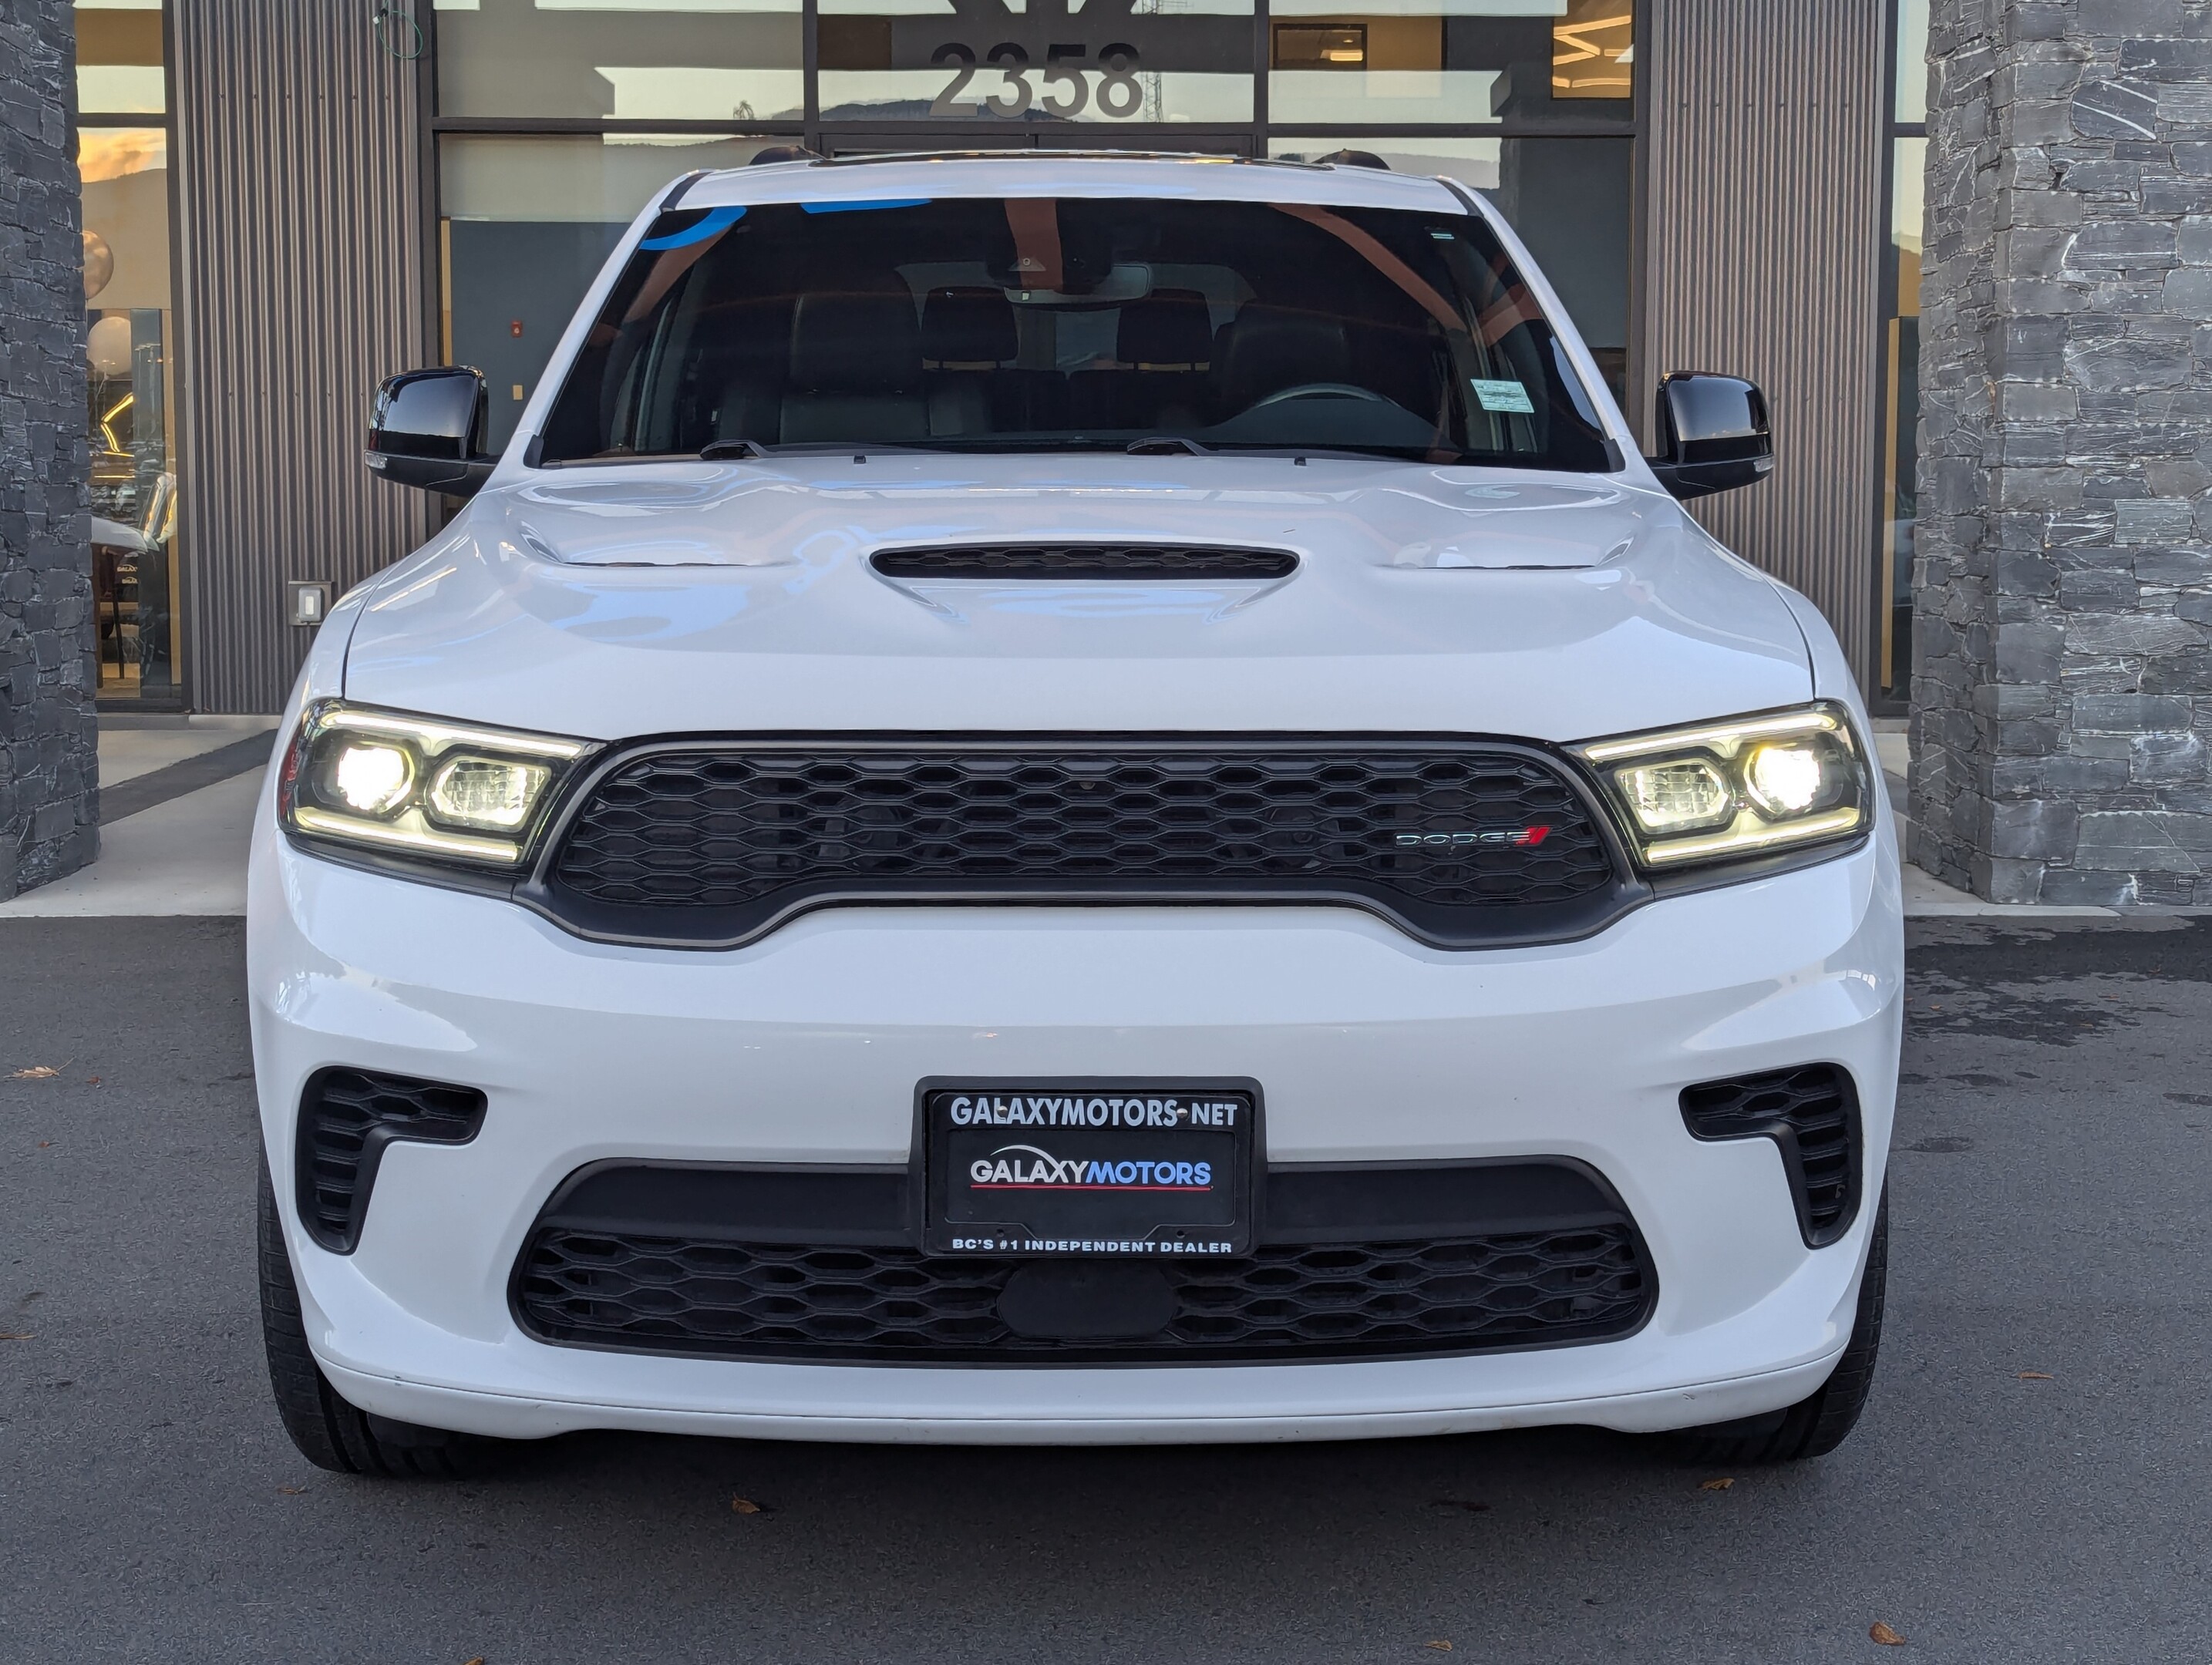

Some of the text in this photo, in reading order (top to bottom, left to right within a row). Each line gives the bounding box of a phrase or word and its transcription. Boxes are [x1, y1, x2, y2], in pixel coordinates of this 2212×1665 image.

[929, 42, 1143, 118] 2358
[1396, 831, 1530, 846] DODGE
[952, 1239, 1232, 1253] BC'S #1 INDEPENDENT DEALER
